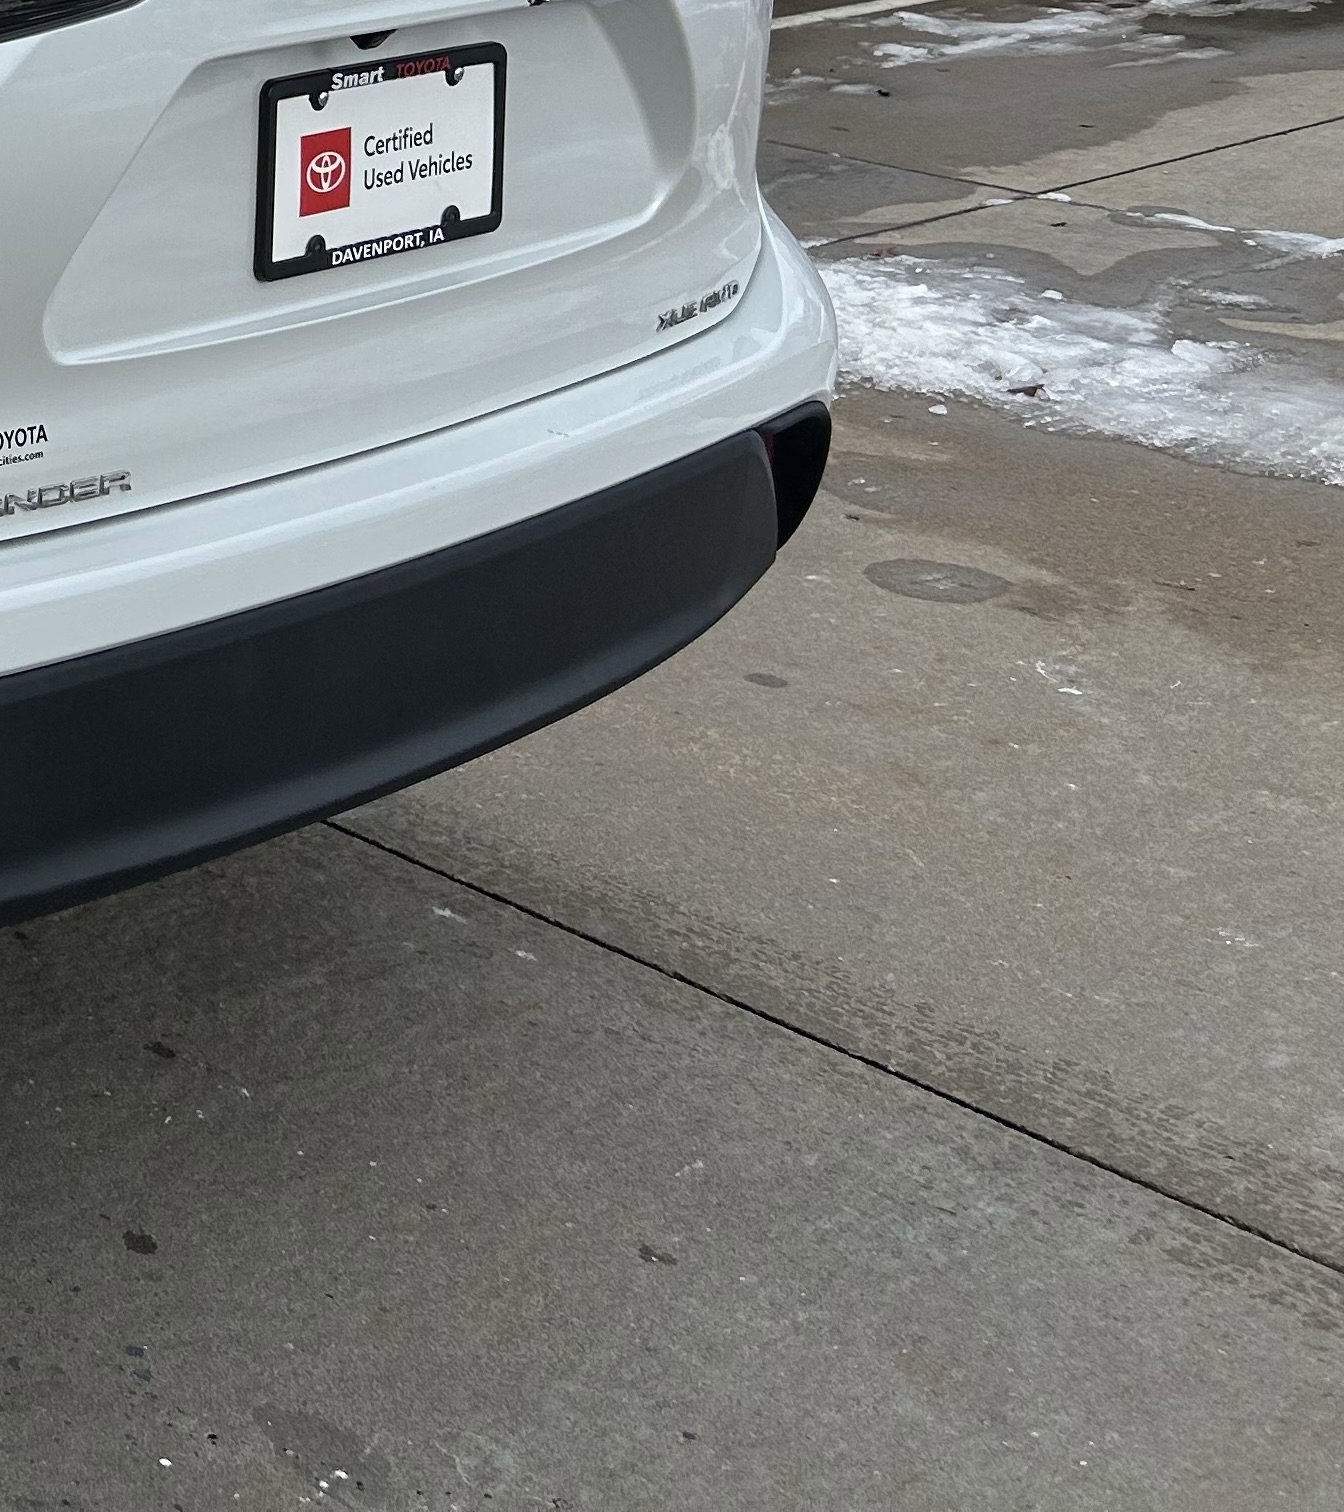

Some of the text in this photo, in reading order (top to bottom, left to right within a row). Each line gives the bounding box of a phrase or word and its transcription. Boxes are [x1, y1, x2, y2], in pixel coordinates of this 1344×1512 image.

[331, 56, 451, 90] Smart TOYOTA
[363, 123, 433, 157] Certified
[363, 152, 473, 190] Used Vehicles
[332, 227, 445, 266] DAVENPORT, IA
